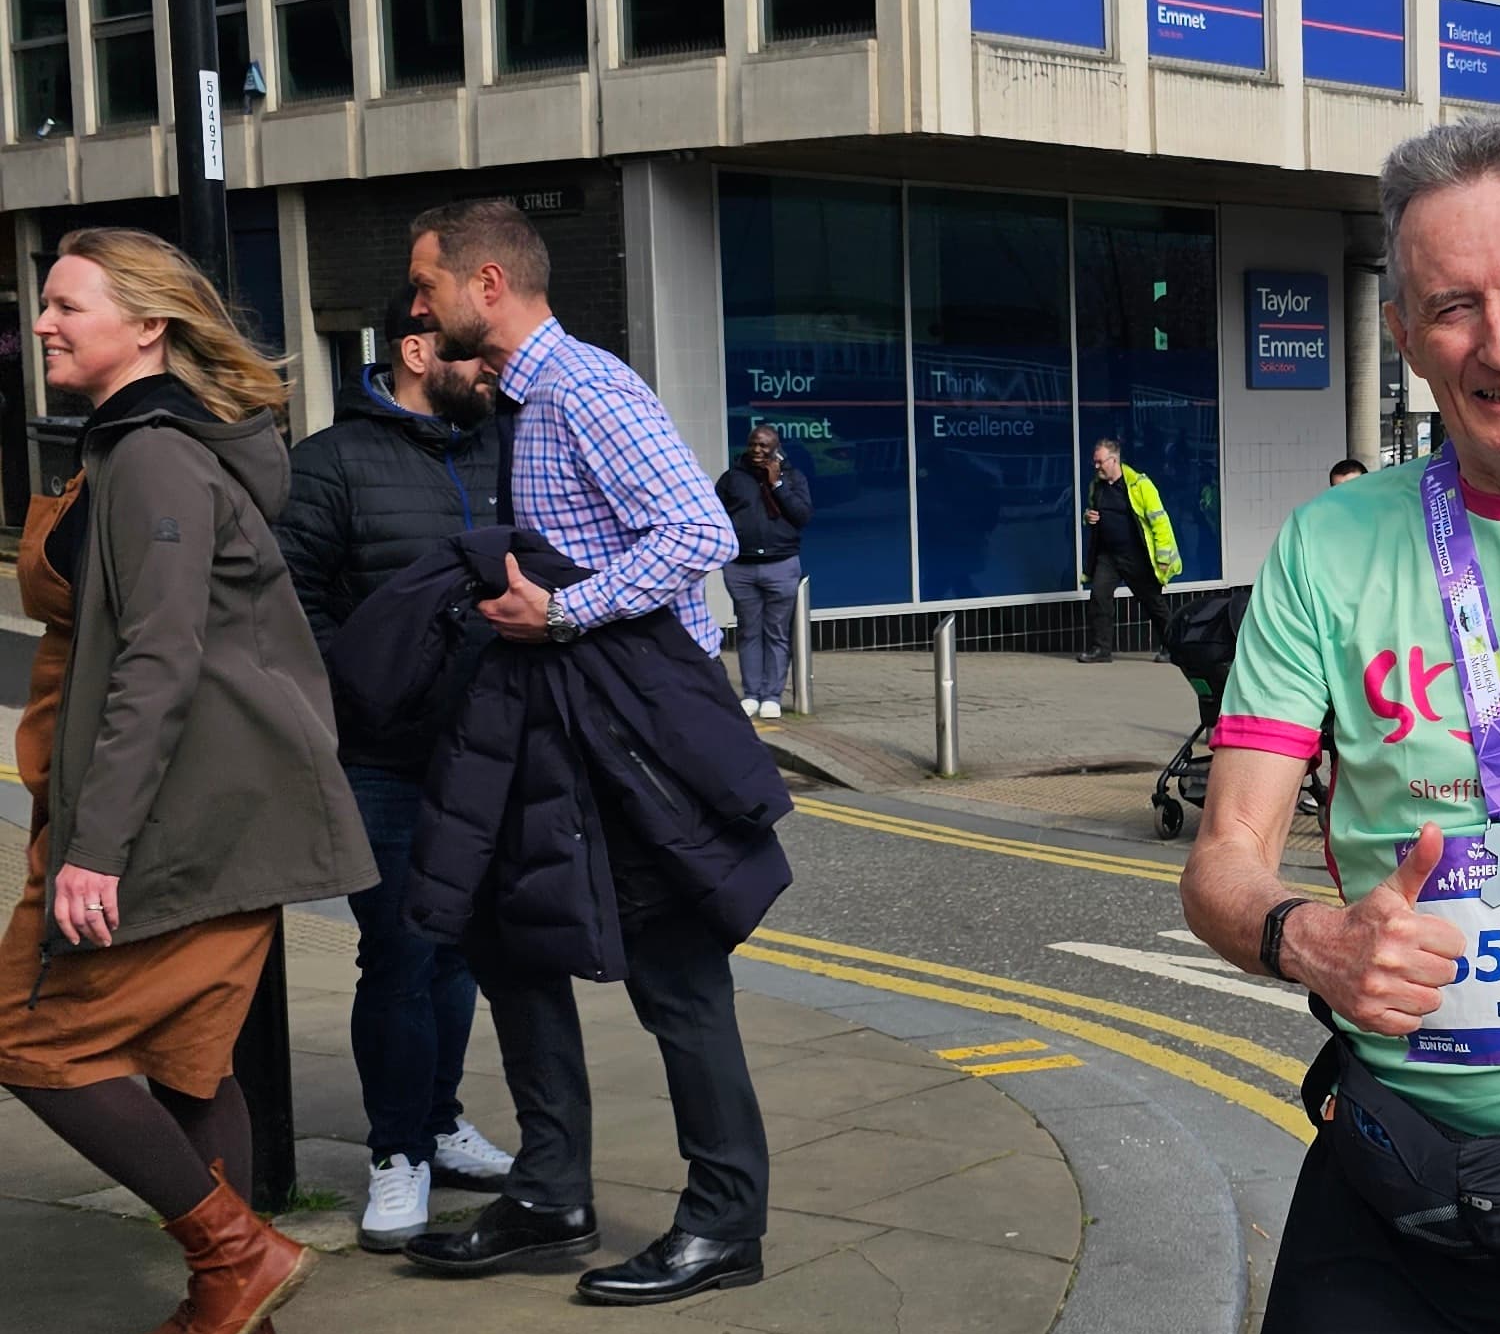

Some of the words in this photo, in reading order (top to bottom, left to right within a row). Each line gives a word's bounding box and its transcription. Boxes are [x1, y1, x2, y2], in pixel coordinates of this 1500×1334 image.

[1157, 5, 1207, 30] Emmet
[1446, 23, 1492, 46] Talented
[1446, 52, 1488, 75] Experts
[206, 80, 217, 167] 504971
[523, 191, 563, 210] STREET
[1257, 287, 1312, 317] Taylor
[1258, 334, 1326, 359] Emmet
[1259, 361, 1297, 373] Solicitors
[748, 369, 815, 398] Taylor
[931, 370, 986, 393] Think
[933, 415, 1035, 438] Excellence
[1437, 494, 1452, 536] SHEFFIELD
[1433, 522, 1451, 575] MARATHON
[1470, 656, 1485, 690] Mutual
[1479, 653, 1497, 693] Sheffield
[1364, 645, 1454, 743] St
[1409, 778, 1486, 803] Sheffi
[1438, 1042, 1454, 1053] FOR
[1454, 1043, 1471, 1053] ALL
